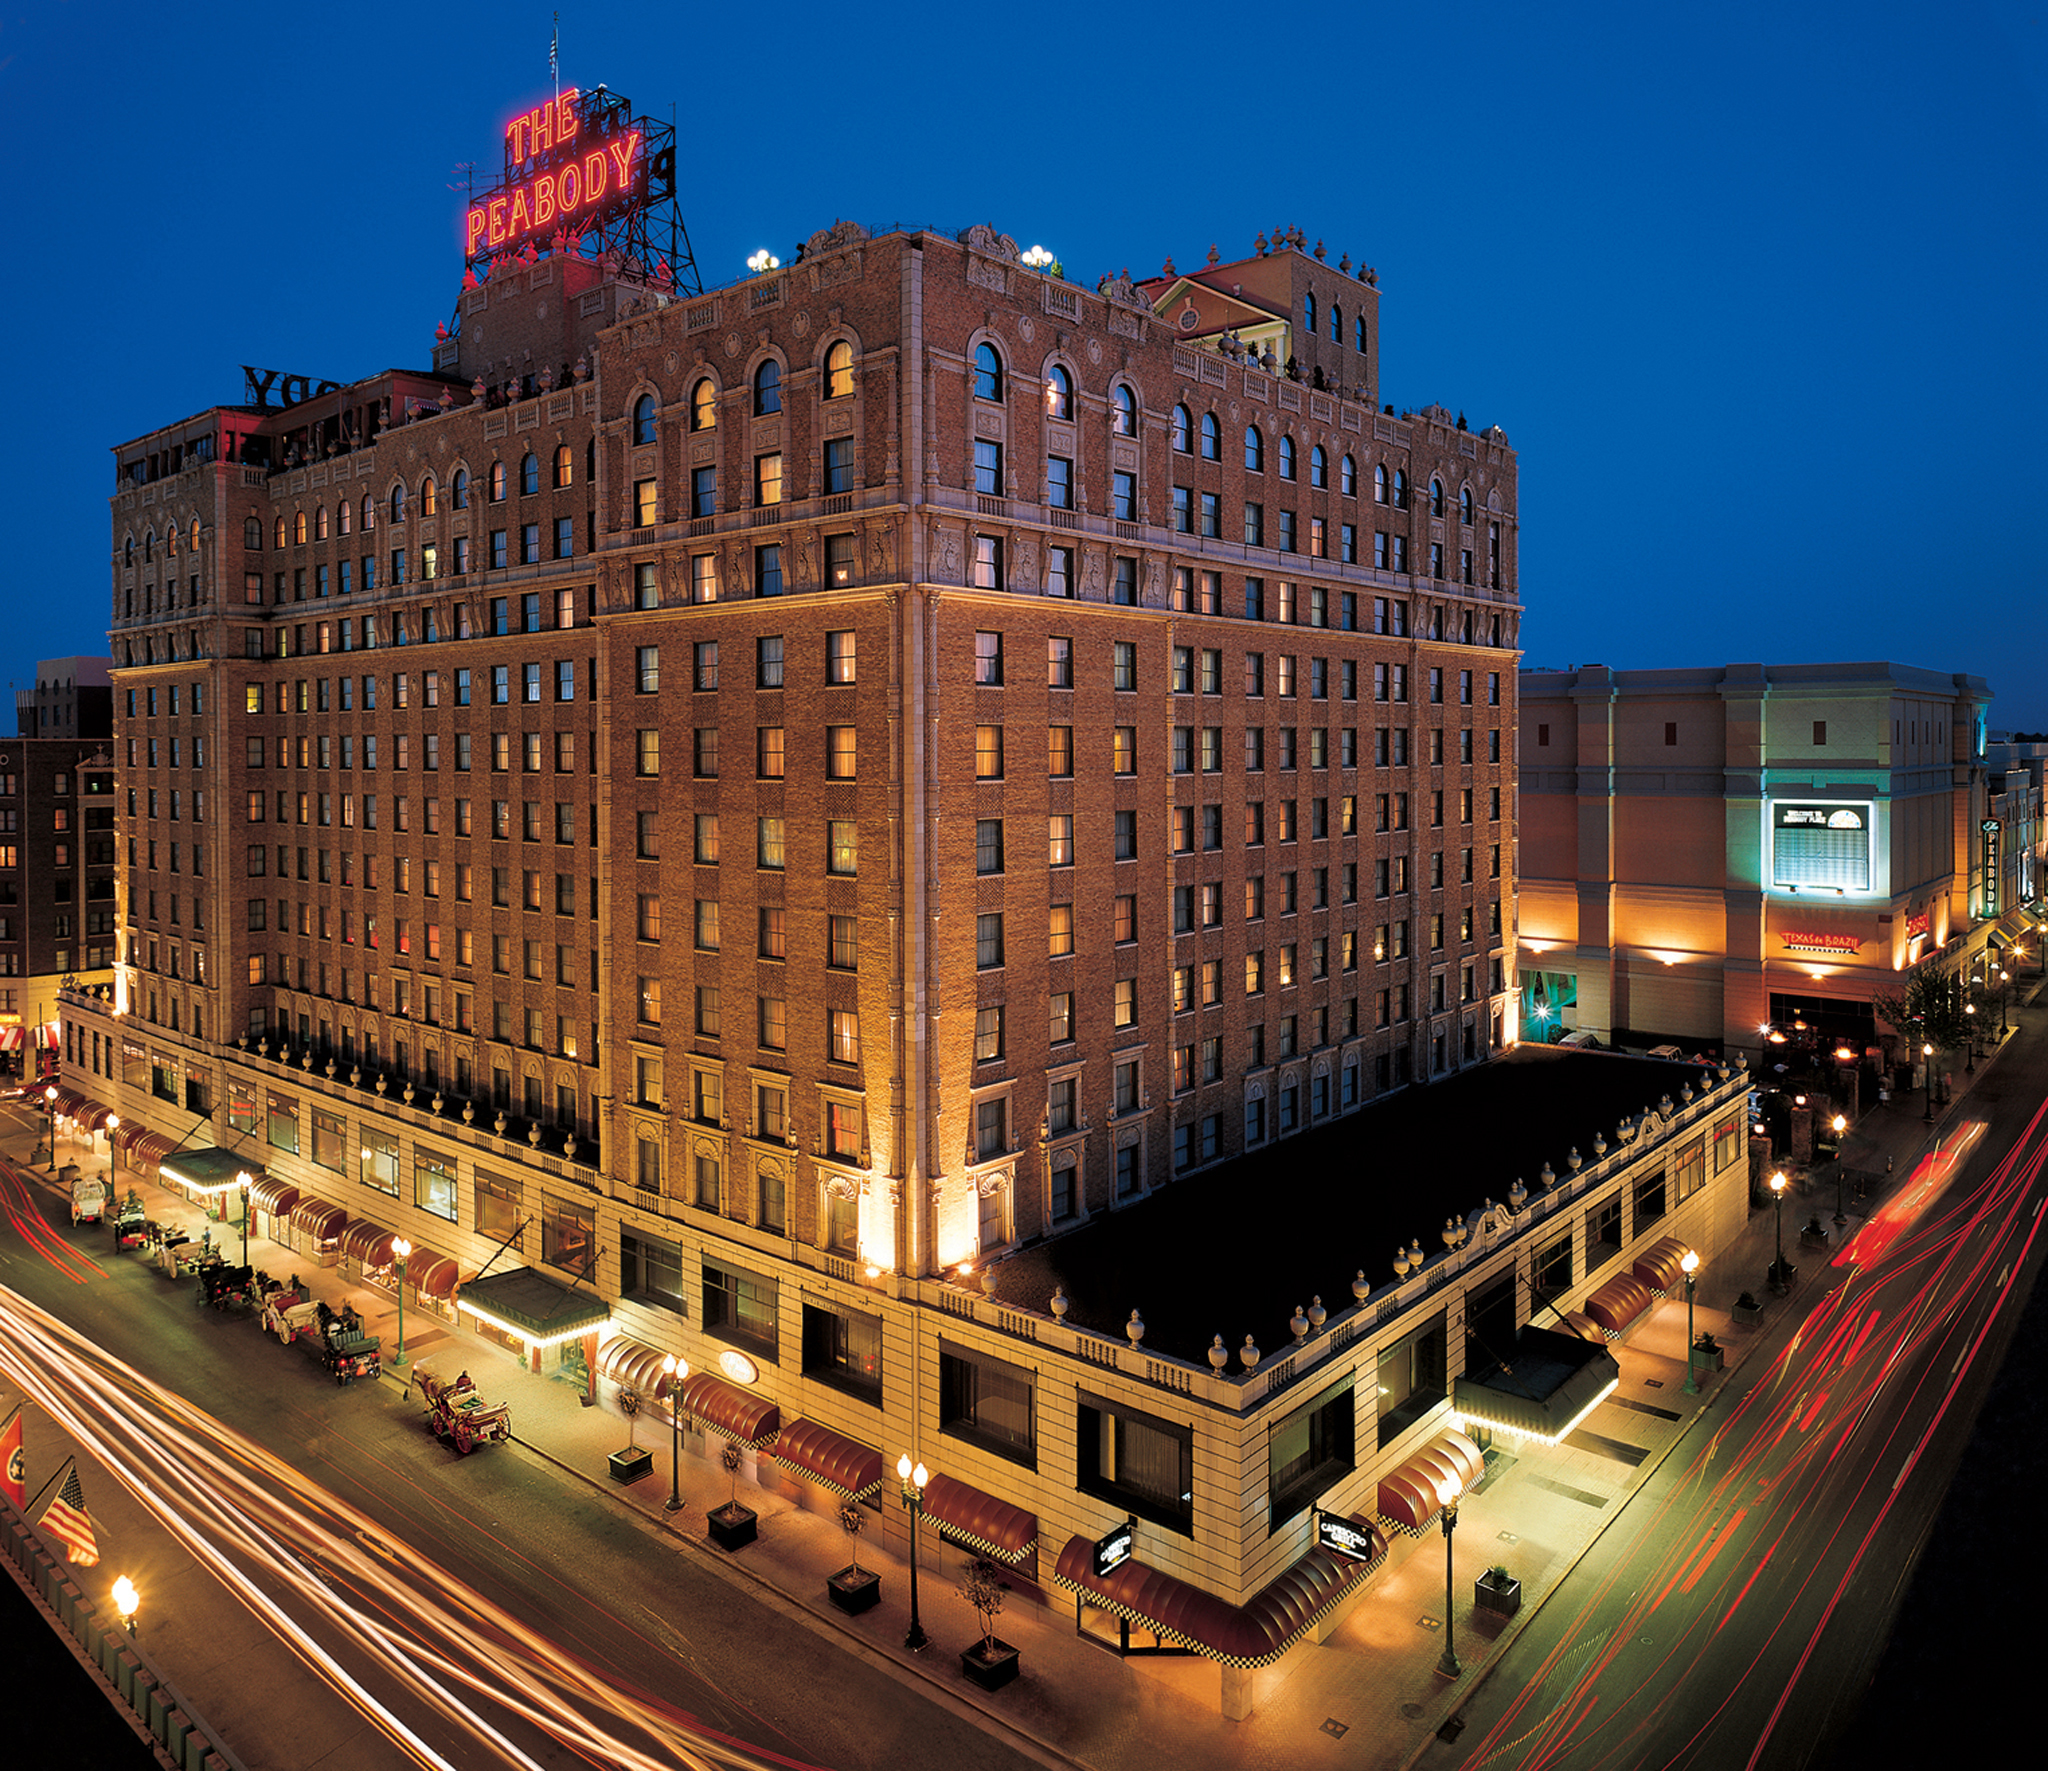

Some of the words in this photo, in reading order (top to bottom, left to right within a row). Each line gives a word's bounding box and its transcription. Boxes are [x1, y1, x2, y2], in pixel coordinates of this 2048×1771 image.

[505, 87, 580, 165] THE
[465, 132, 639, 256] PEABODY
[1986, 832, 1996, 914] PEABODY
[1780, 932, 1814, 945] TEXAS
[1824, 933, 1860, 951] BRAZIL
